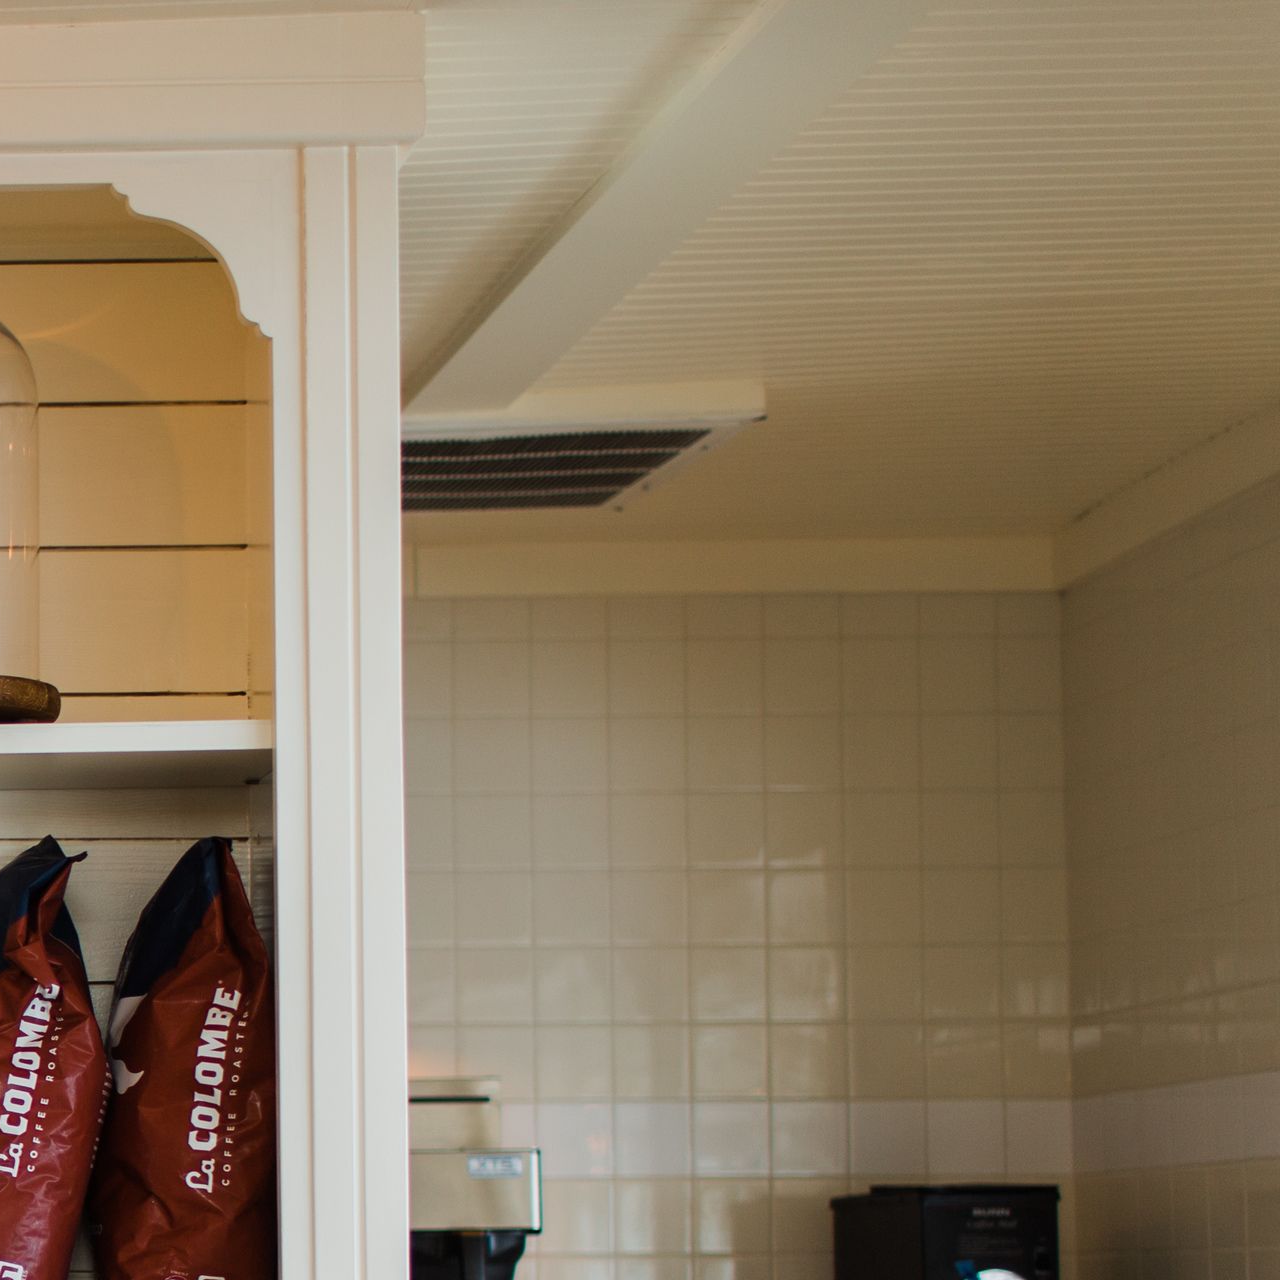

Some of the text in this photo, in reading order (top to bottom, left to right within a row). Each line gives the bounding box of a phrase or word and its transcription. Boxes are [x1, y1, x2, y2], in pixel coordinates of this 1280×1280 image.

[27, 1008, 65, 1172] COFFEE ROASTE
[185, 986, 242, 1194] La COLOMBE
[221, 1000, 250, 1186] COFFEE ROASTER
